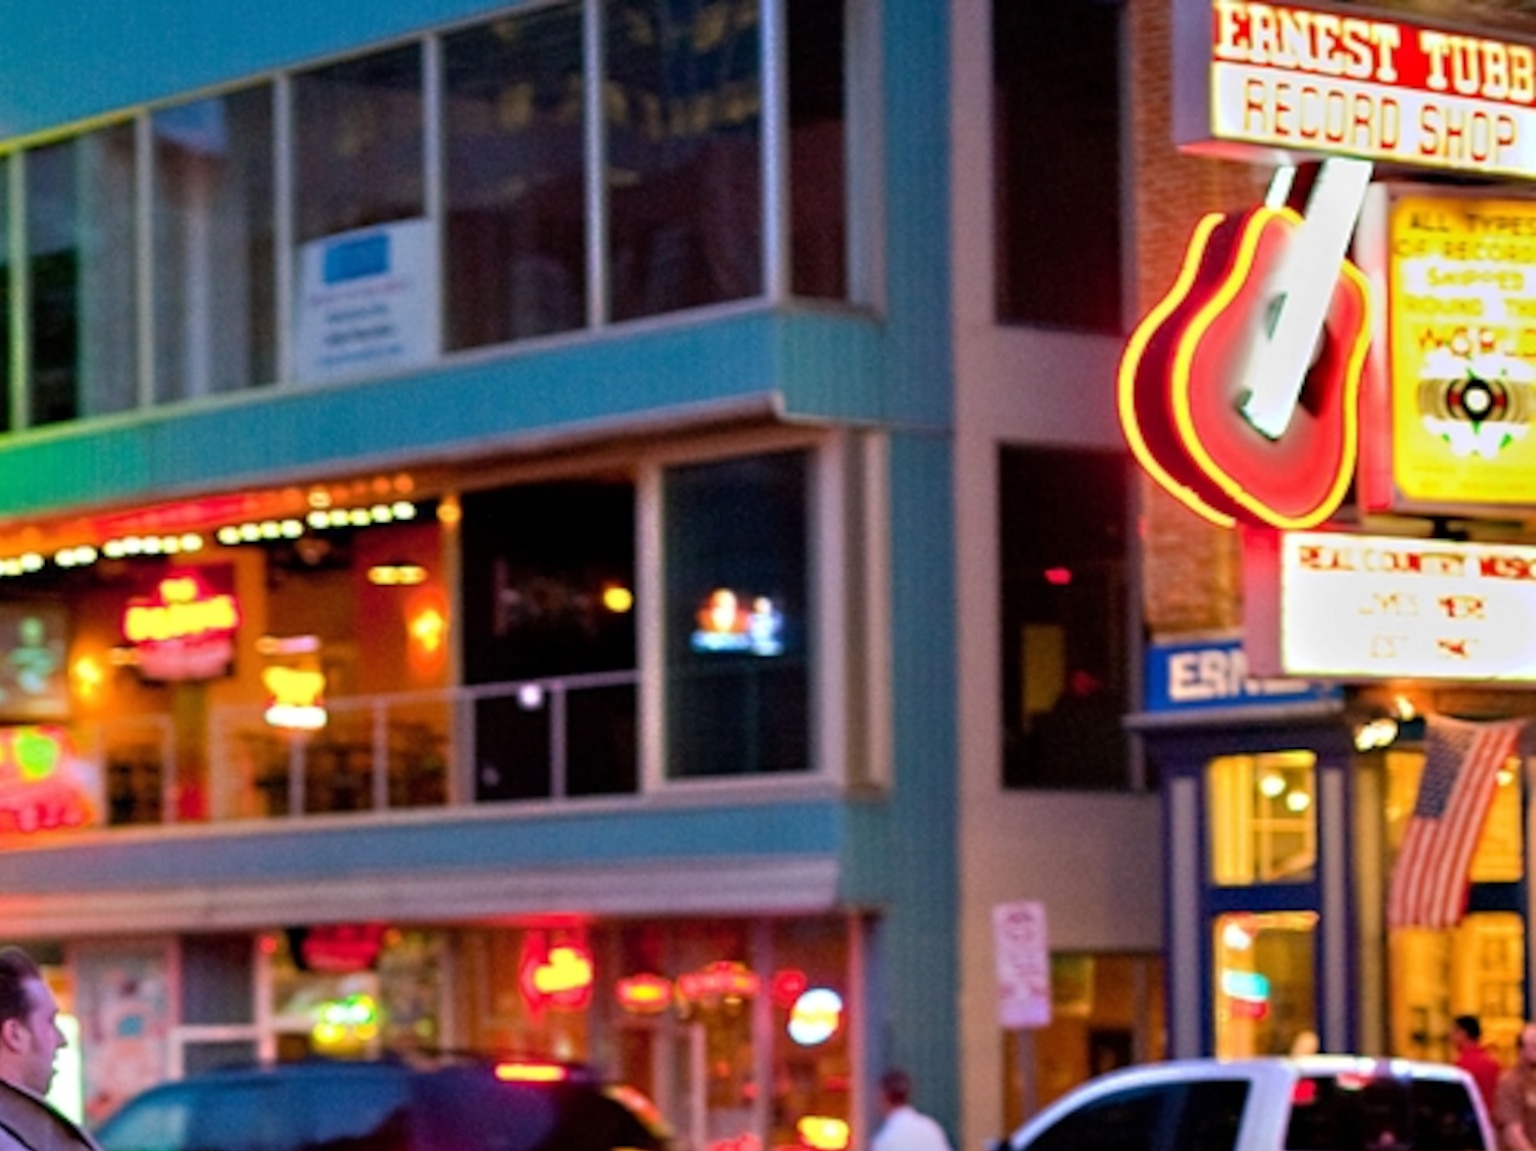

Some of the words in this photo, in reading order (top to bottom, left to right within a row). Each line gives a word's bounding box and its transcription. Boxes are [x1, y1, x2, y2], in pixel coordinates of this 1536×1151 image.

[1215, 1, 1398, 82] ERNEST
[1419, 29, 1535, 103] TUBB
[1244, 77, 1399, 150] RECORD
[1420, 103, 1516, 165] SHOP
